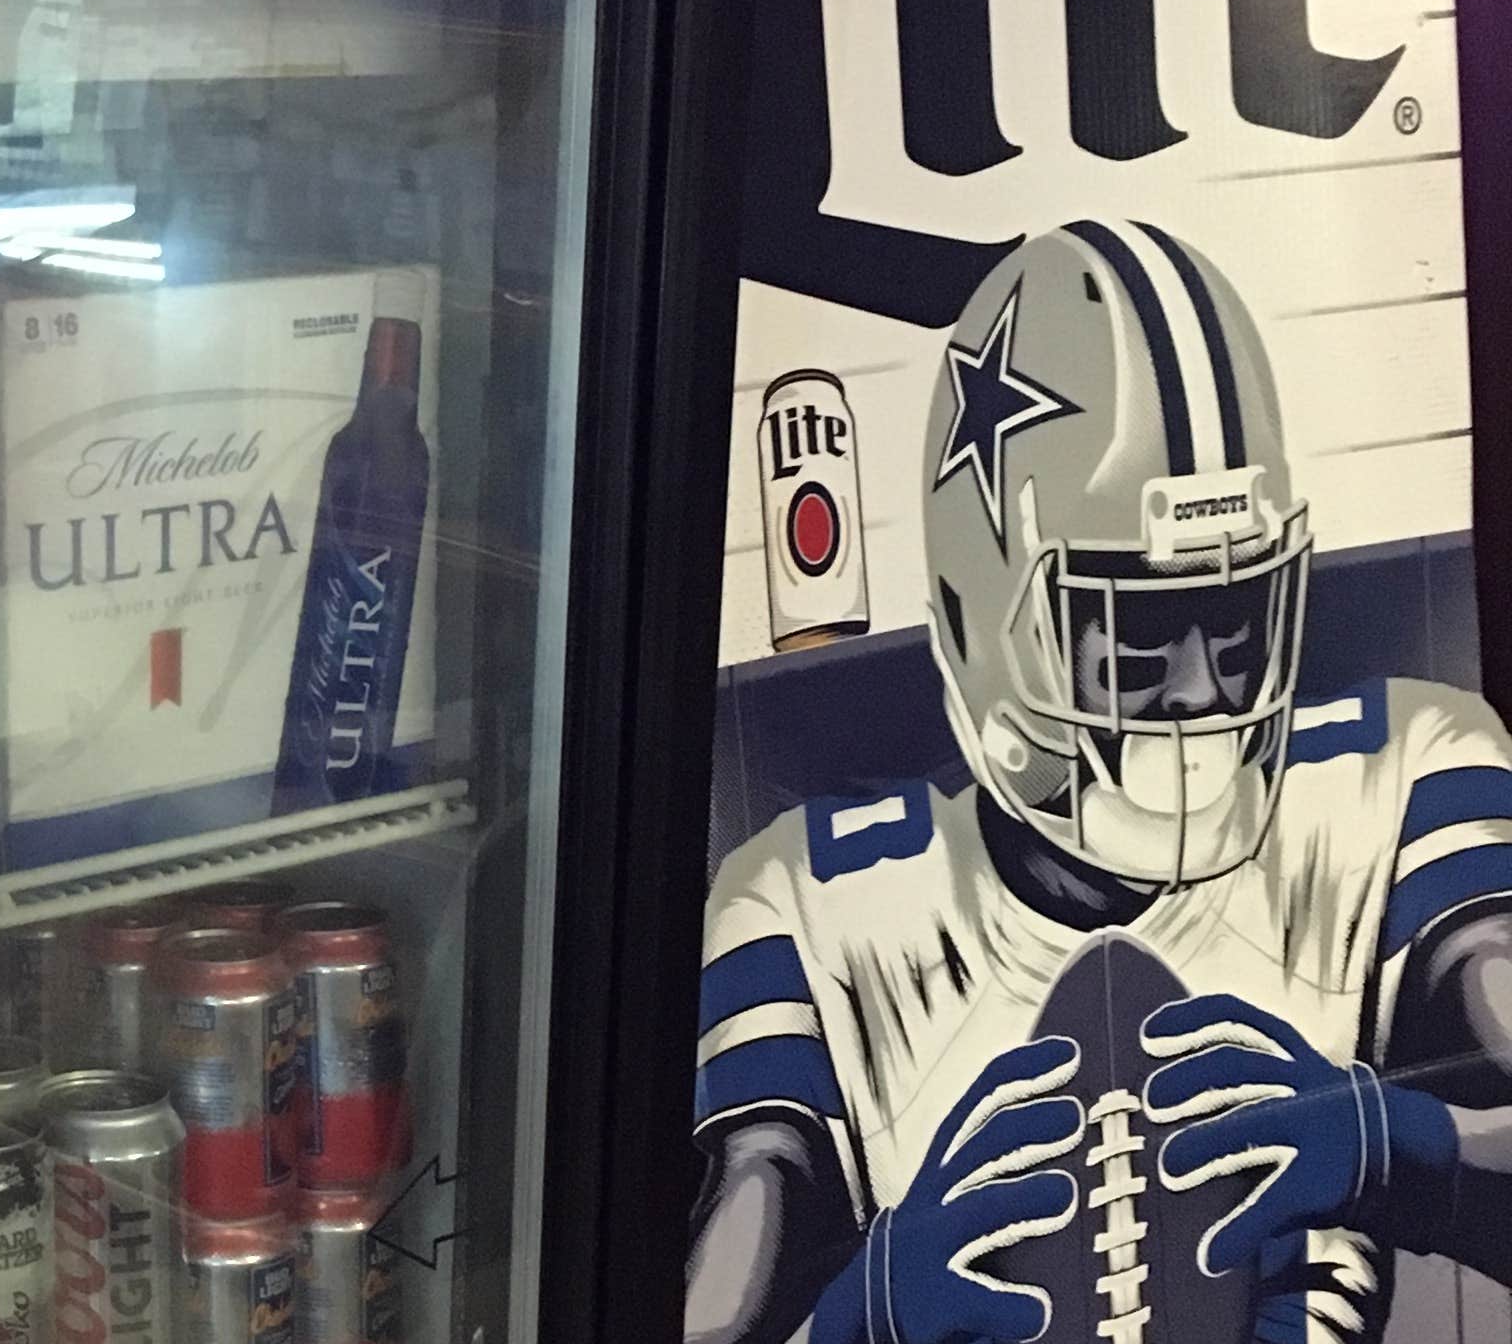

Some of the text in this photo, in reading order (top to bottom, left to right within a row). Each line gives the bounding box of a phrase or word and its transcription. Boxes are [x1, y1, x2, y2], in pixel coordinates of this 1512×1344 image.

[24, 312, 80, 341] 8 16
[65, 429, 264, 499] Michelob
[766, 405, 848, 482] Lite
[24, 490, 298, 590] ULTRA
[1174, 494, 1248, 521] COWBOYS
[326, 545, 392, 771] ULTRA
